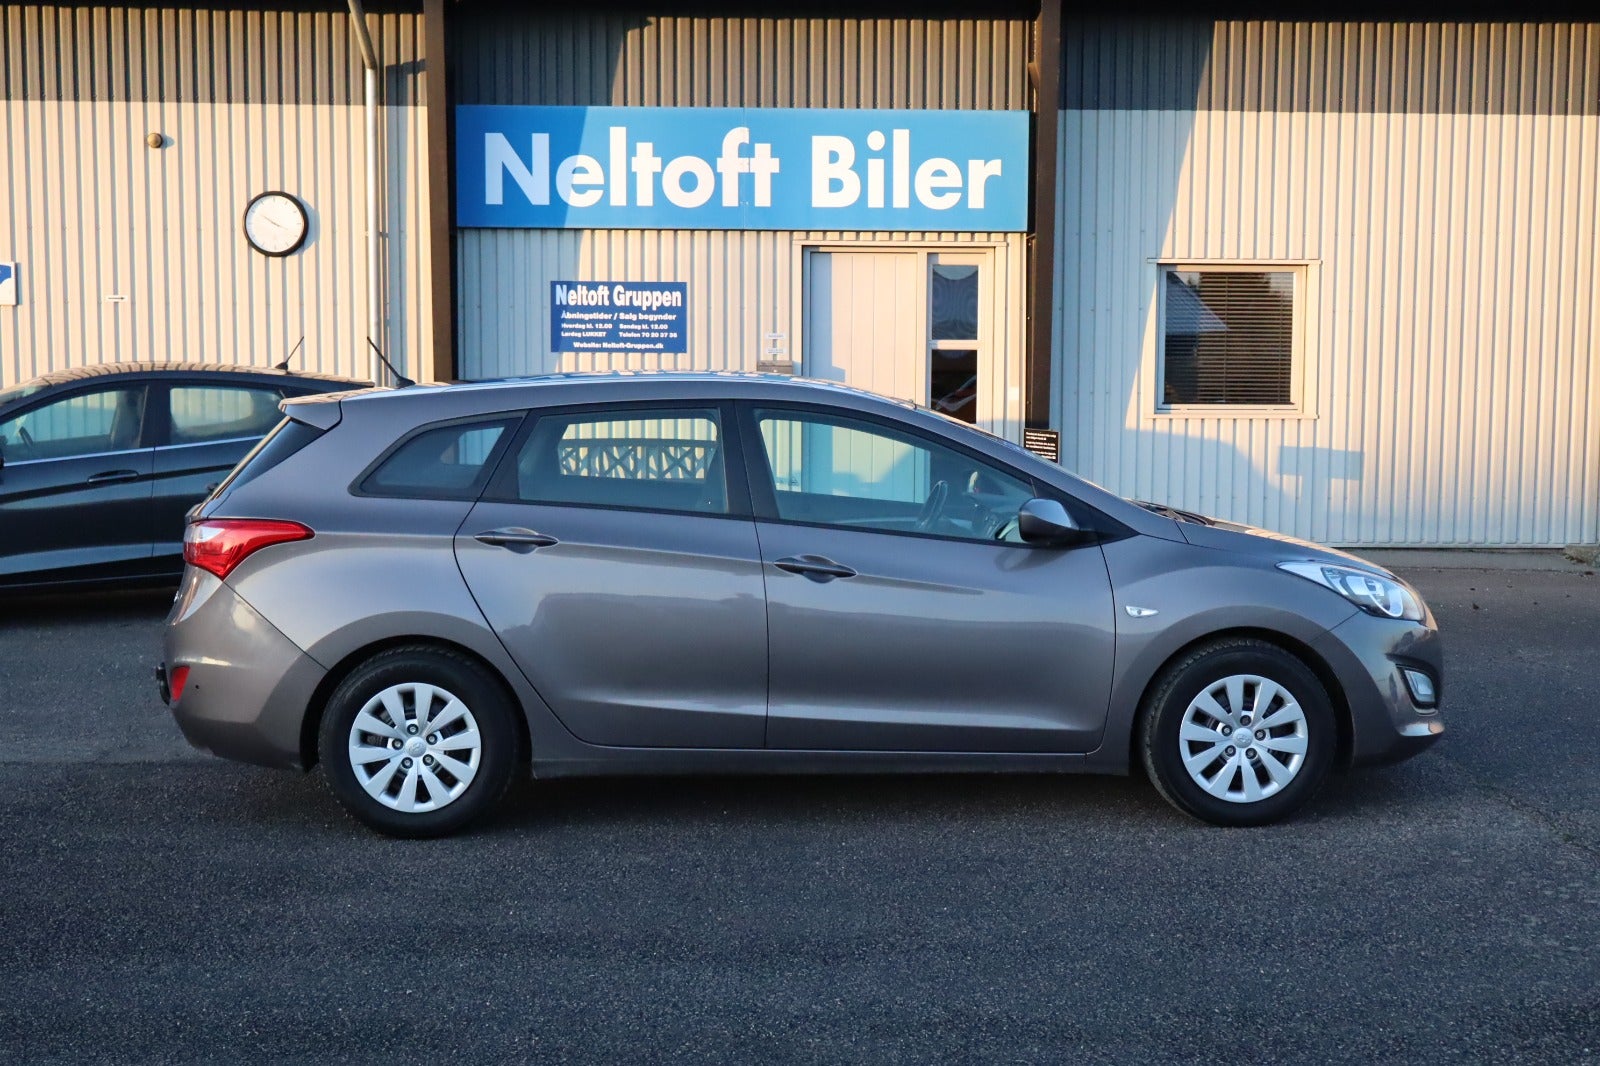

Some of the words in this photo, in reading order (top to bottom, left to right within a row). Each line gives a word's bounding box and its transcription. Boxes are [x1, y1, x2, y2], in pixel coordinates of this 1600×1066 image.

[484, 126, 780, 208] Neltoft
[810, 128, 1003, 209] Biler
[555, 284, 609, 307] Neltoft
[613, 286, 682, 311] Gruppen
[561, 310, 612, 320] Åbningstider
[619, 312, 637, 321] Salg
[639, 313, 676, 321] begynder
